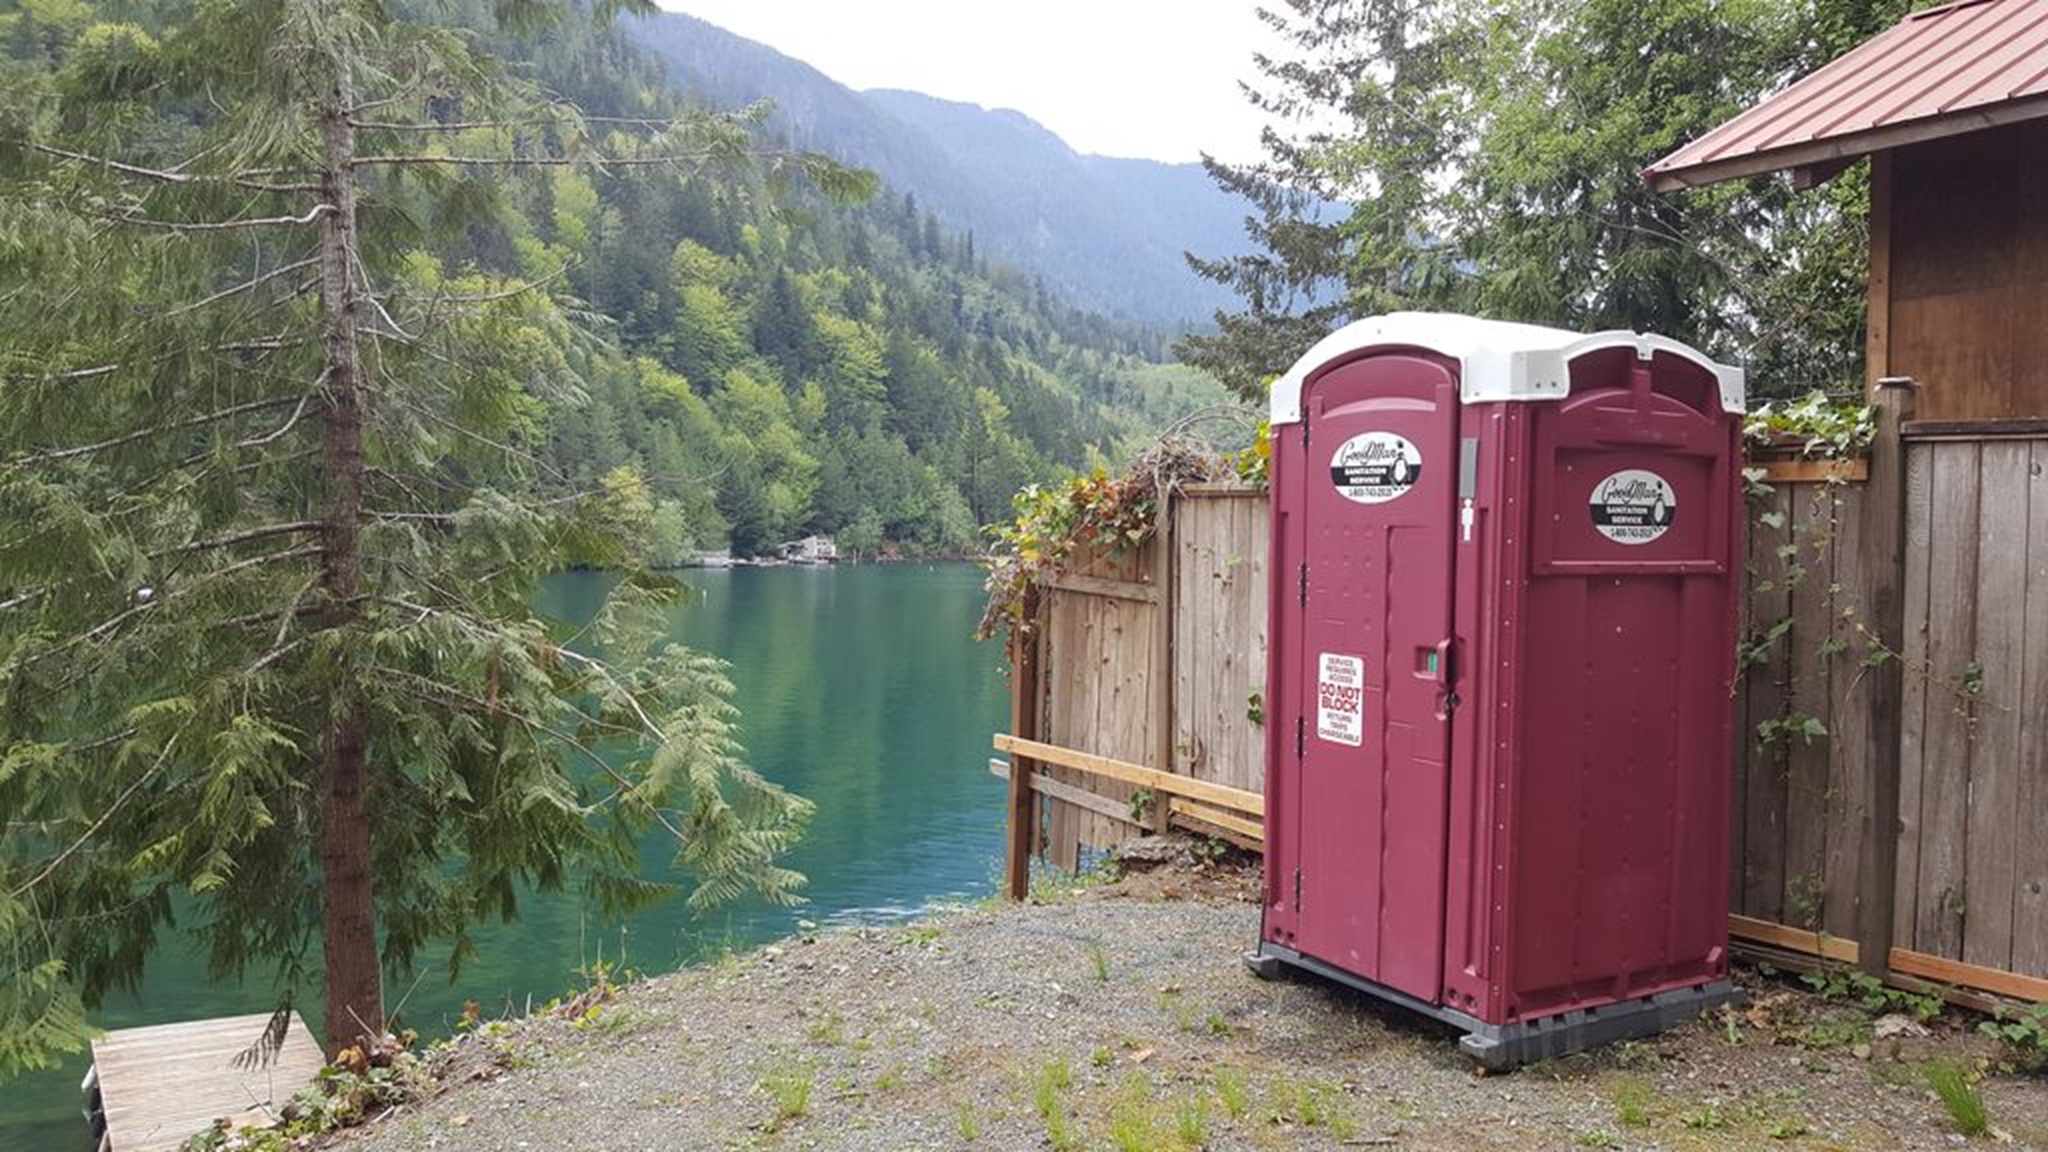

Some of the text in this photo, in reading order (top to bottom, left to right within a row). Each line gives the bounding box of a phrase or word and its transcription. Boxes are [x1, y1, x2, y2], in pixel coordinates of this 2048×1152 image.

[1344, 467, 1387, 476] SANITATION
[1349, 476, 1381, 485] SERVICE
[1606, 505, 1649, 515] SANITATION
[1611, 515, 1643, 525] SERVICE
[1327, 656, 1353, 667] SERVICE
[1320, 682, 1361, 700] DO NOT
[1321, 695, 1359, 714] BLOCK
